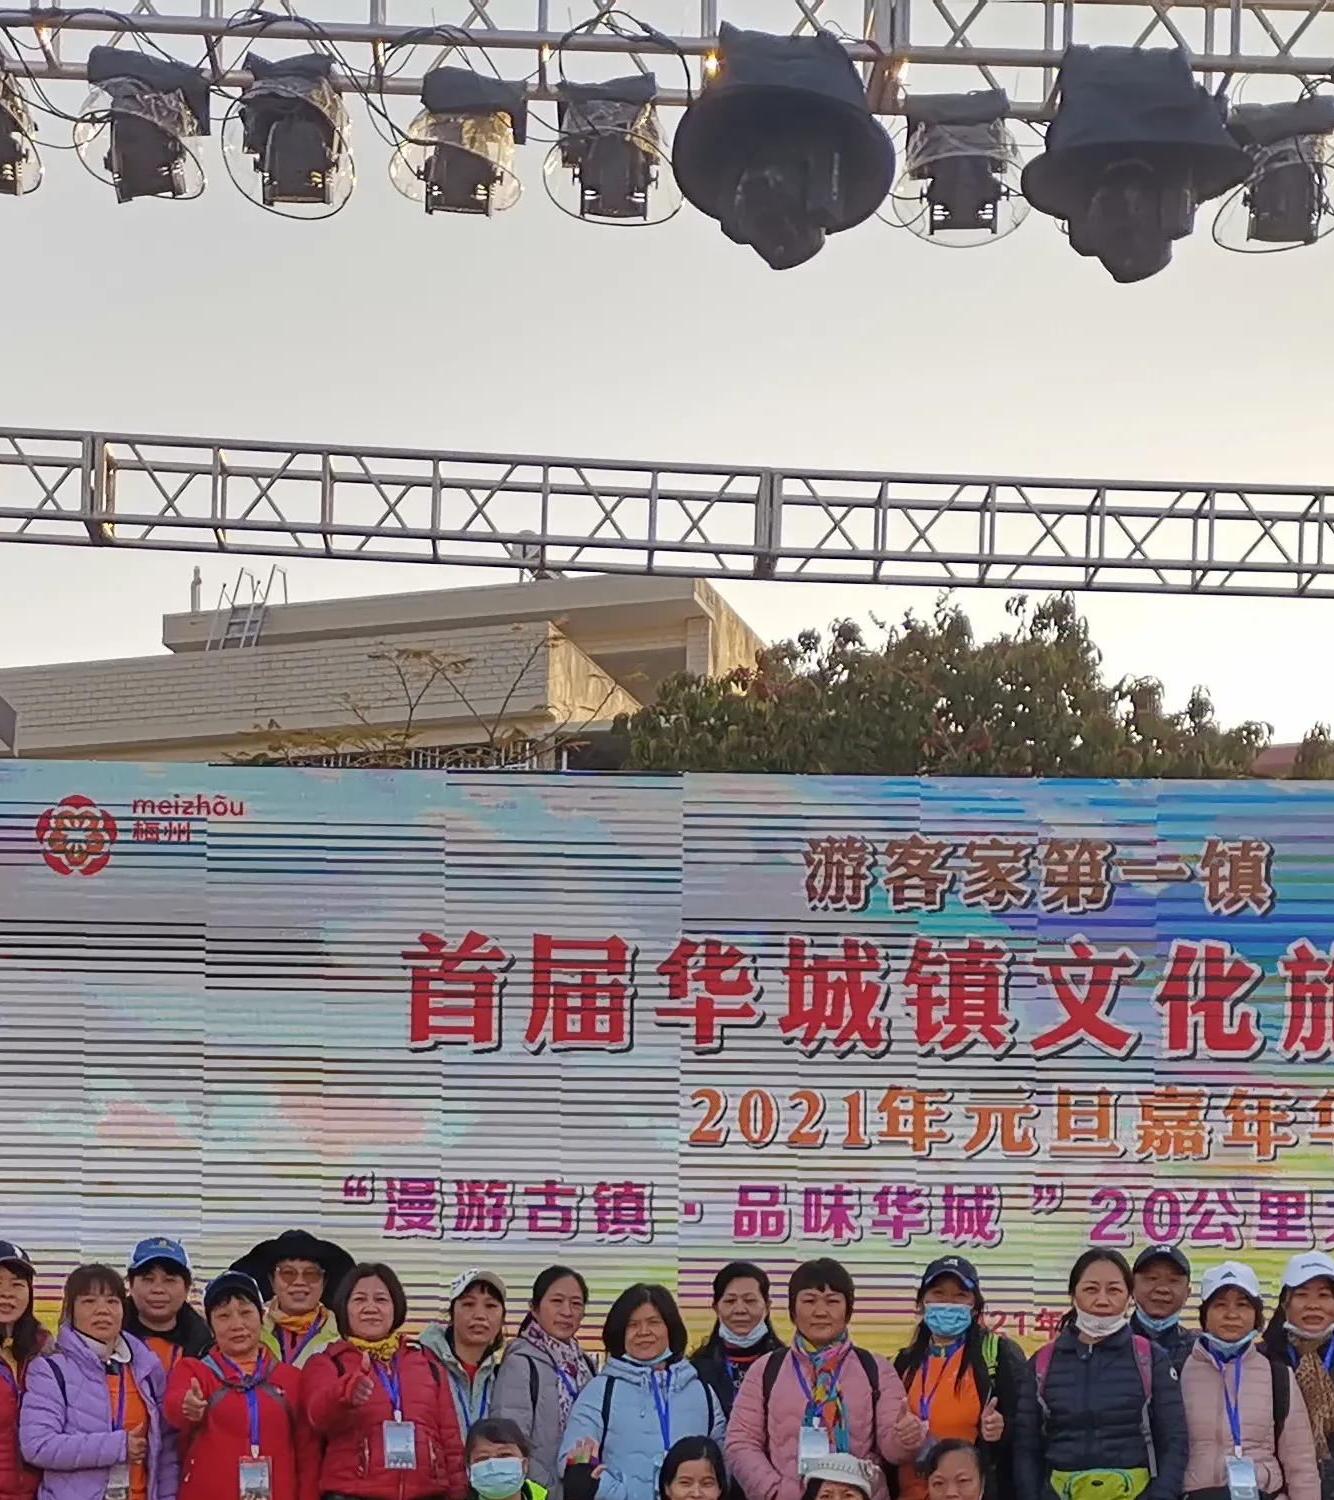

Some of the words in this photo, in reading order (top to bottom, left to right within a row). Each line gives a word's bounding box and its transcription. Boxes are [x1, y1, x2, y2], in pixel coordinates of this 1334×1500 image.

[132, 820, 191, 843] 梅州
[802, 834, 1275, 914] 游客家第一镇
[977, 1308, 1065, 1341] 21年
